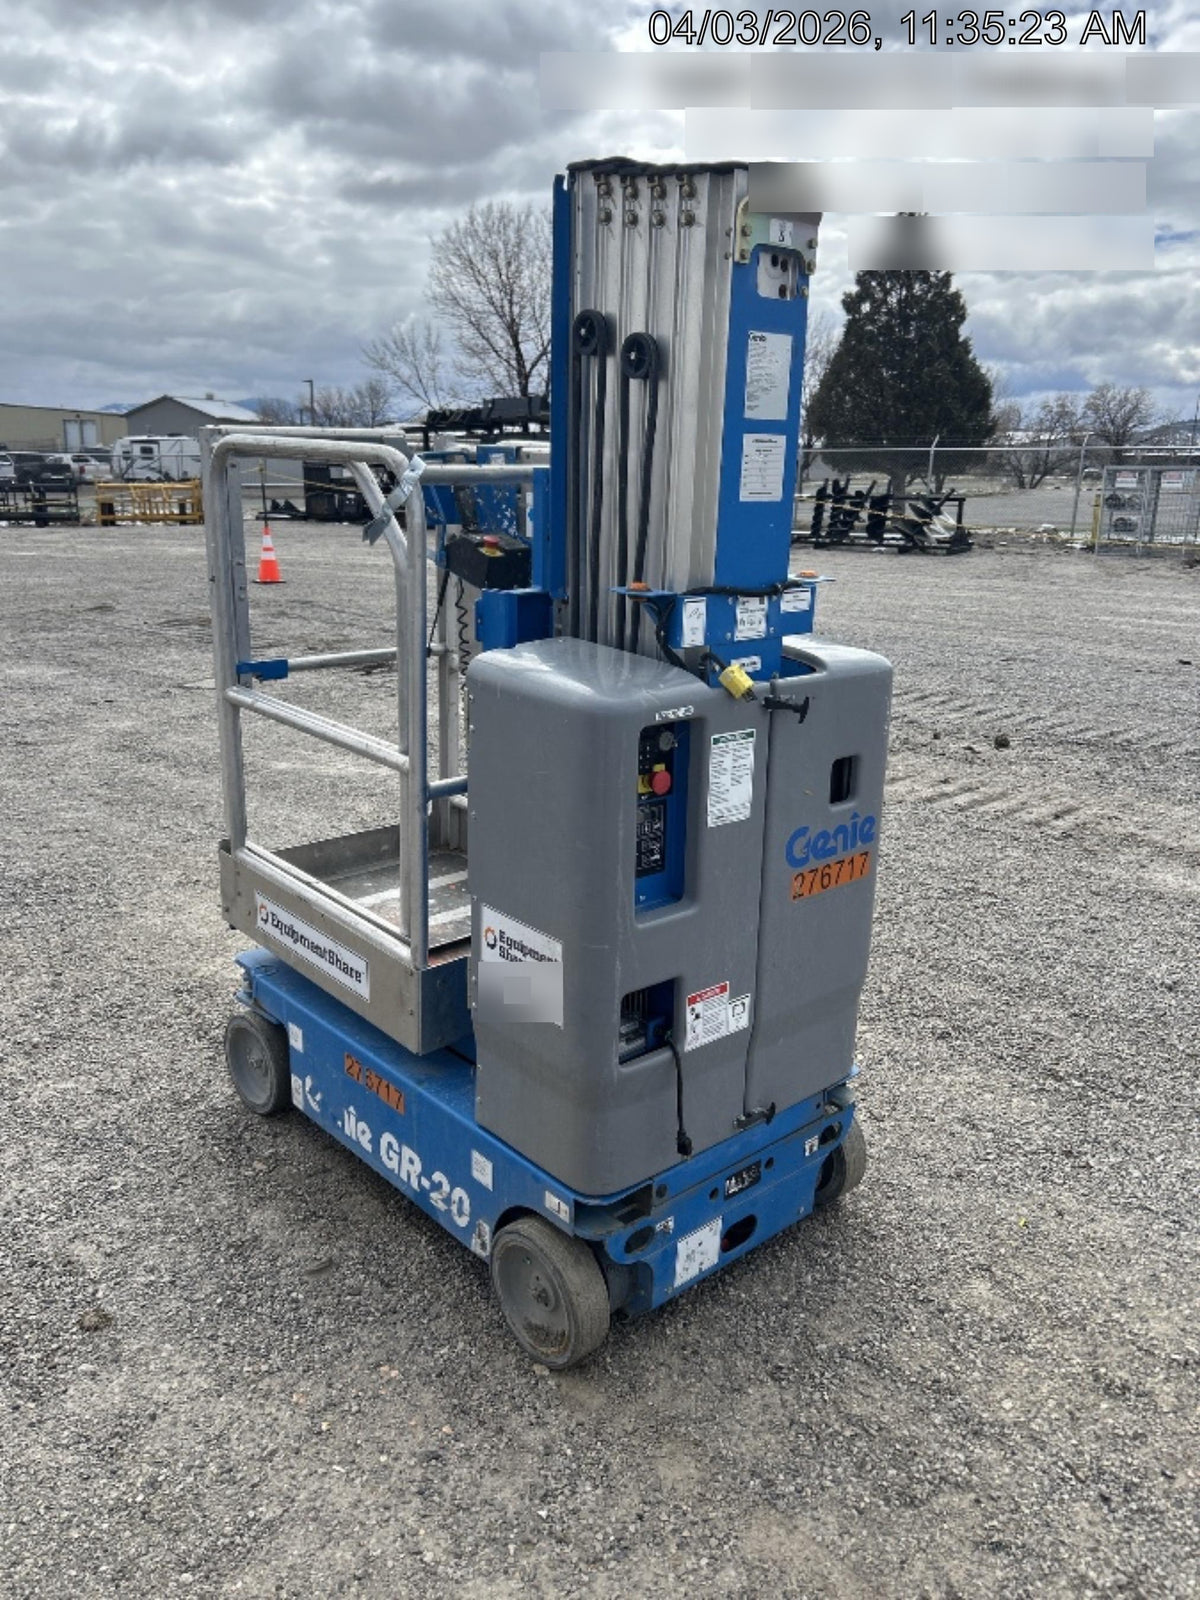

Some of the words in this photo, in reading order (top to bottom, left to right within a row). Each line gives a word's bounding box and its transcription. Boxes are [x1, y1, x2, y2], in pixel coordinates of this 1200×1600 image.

[785, 811, 876, 868] Genie
[792, 851, 870, 901] 276717
[379, 1131, 472, 1228] GR-20
